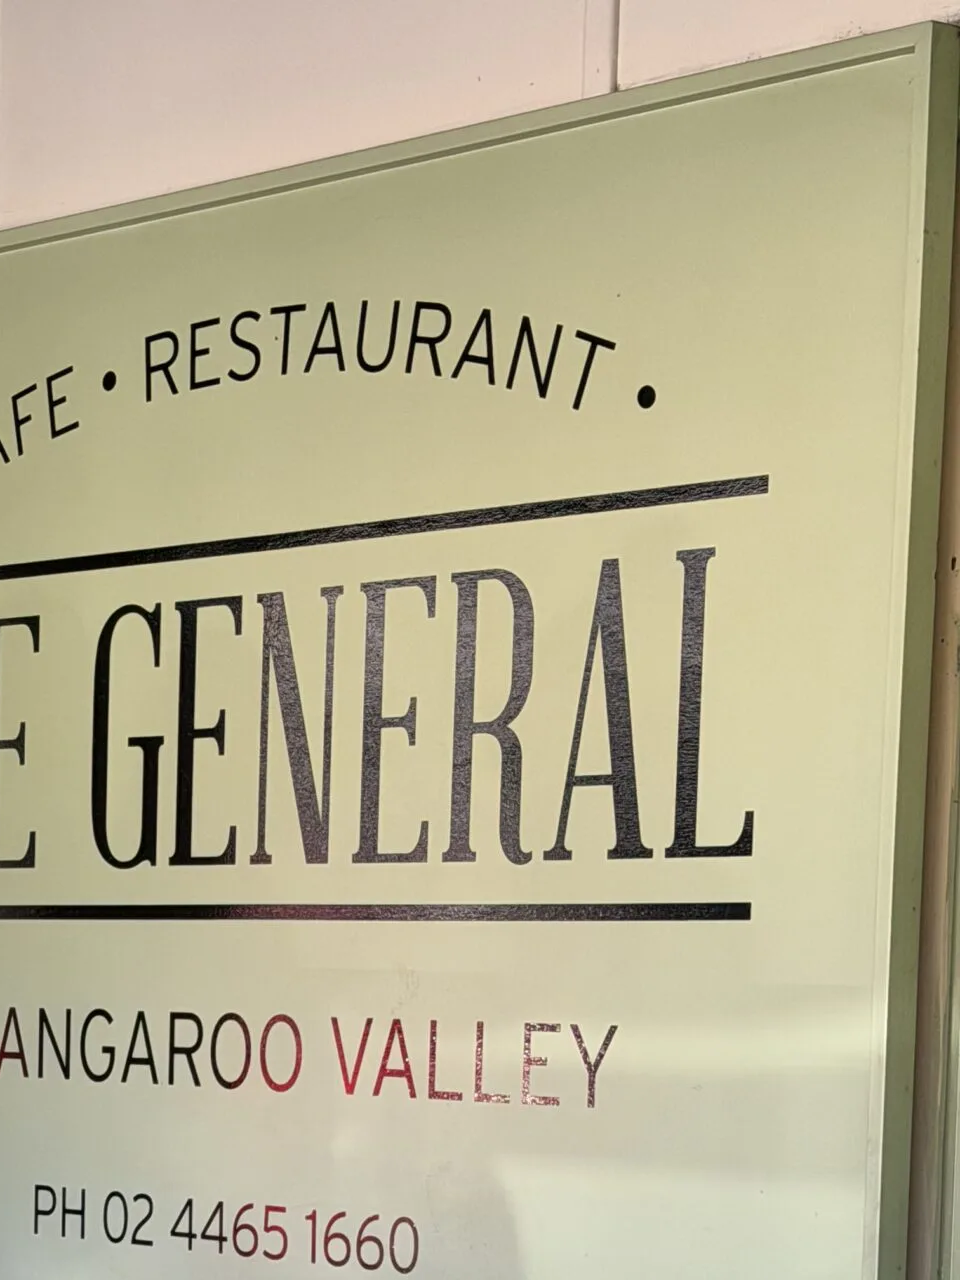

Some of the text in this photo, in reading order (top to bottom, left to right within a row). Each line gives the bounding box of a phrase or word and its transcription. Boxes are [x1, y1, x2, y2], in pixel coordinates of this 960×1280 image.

[145, 301, 617, 411] RESTAURANT
[91, 545, 755, 870] GENERAL
[331, 1016, 619, 1109] VALLEY
[34, 1183, 420, 1275] PH 02 4465 1660
